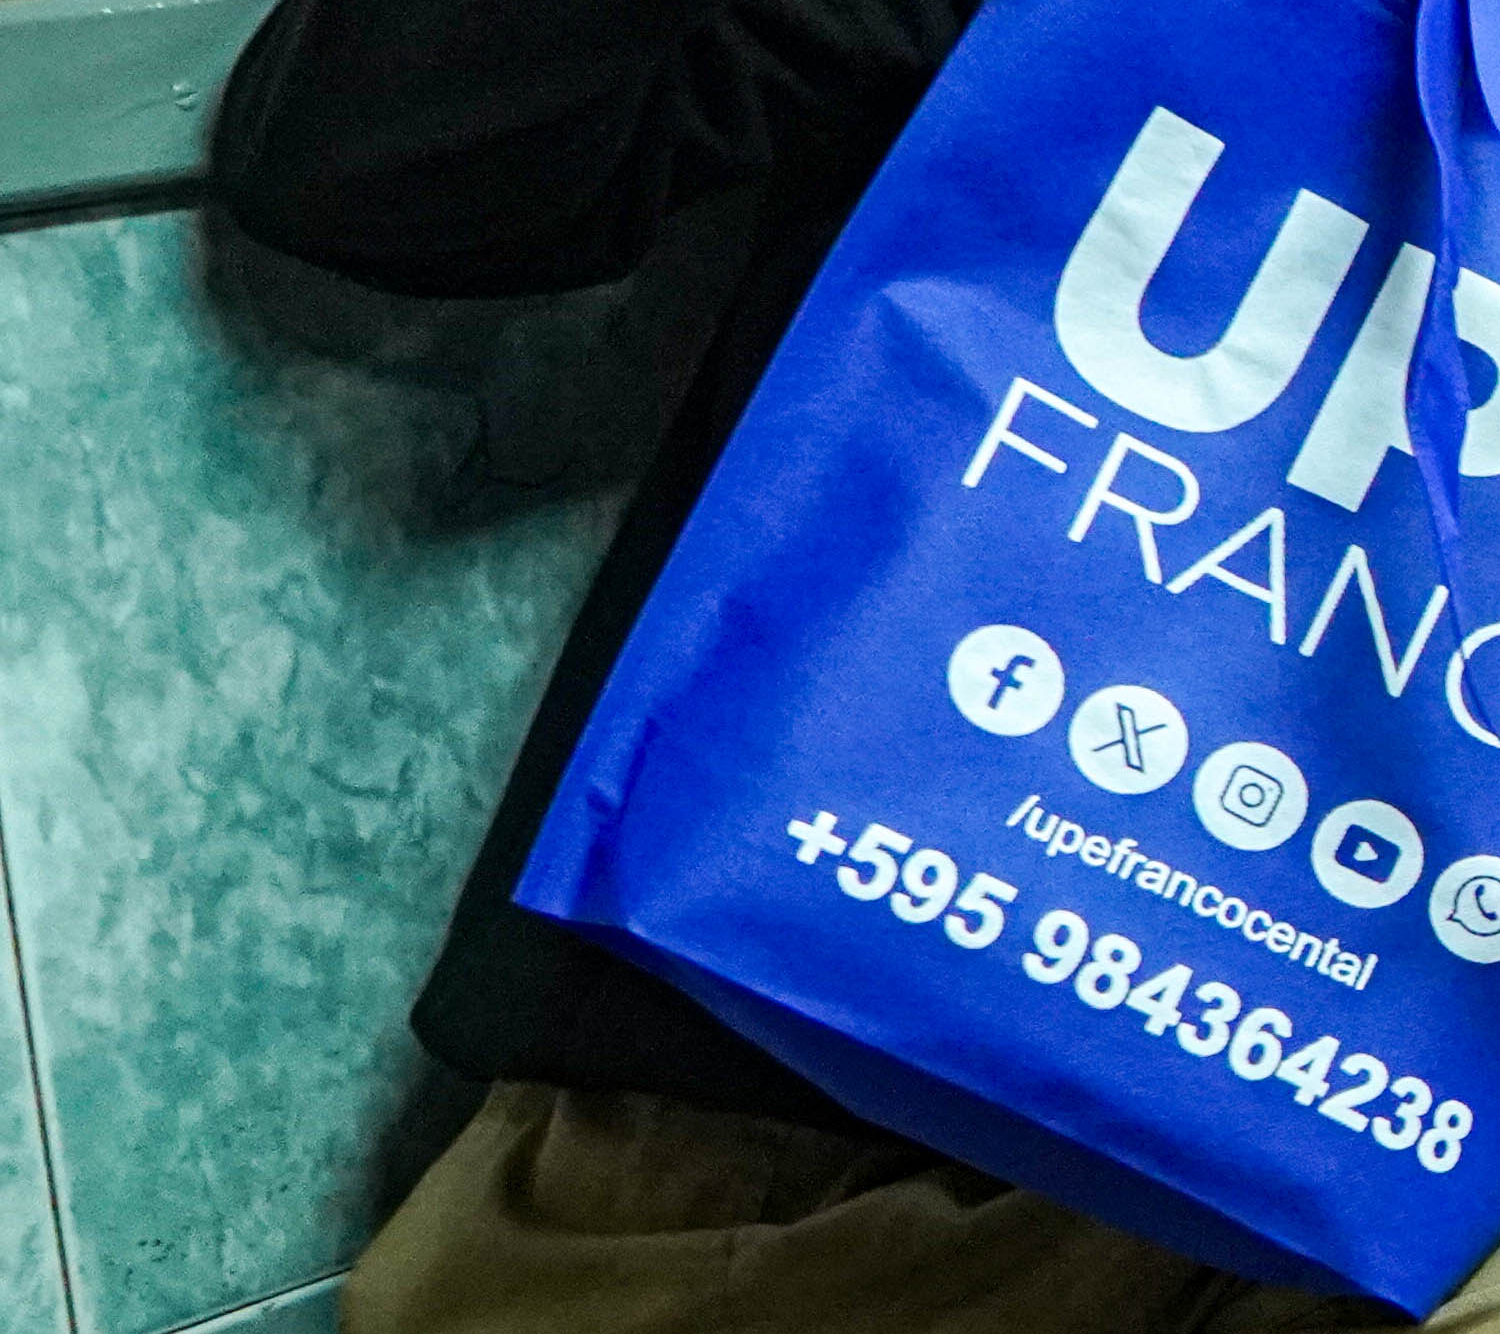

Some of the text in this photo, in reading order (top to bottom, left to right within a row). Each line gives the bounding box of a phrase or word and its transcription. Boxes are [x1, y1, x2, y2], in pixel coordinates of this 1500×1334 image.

[787, 809, 1473, 1173] +595 984364238
[1006, 794, 1378, 990] /upefrancocental
